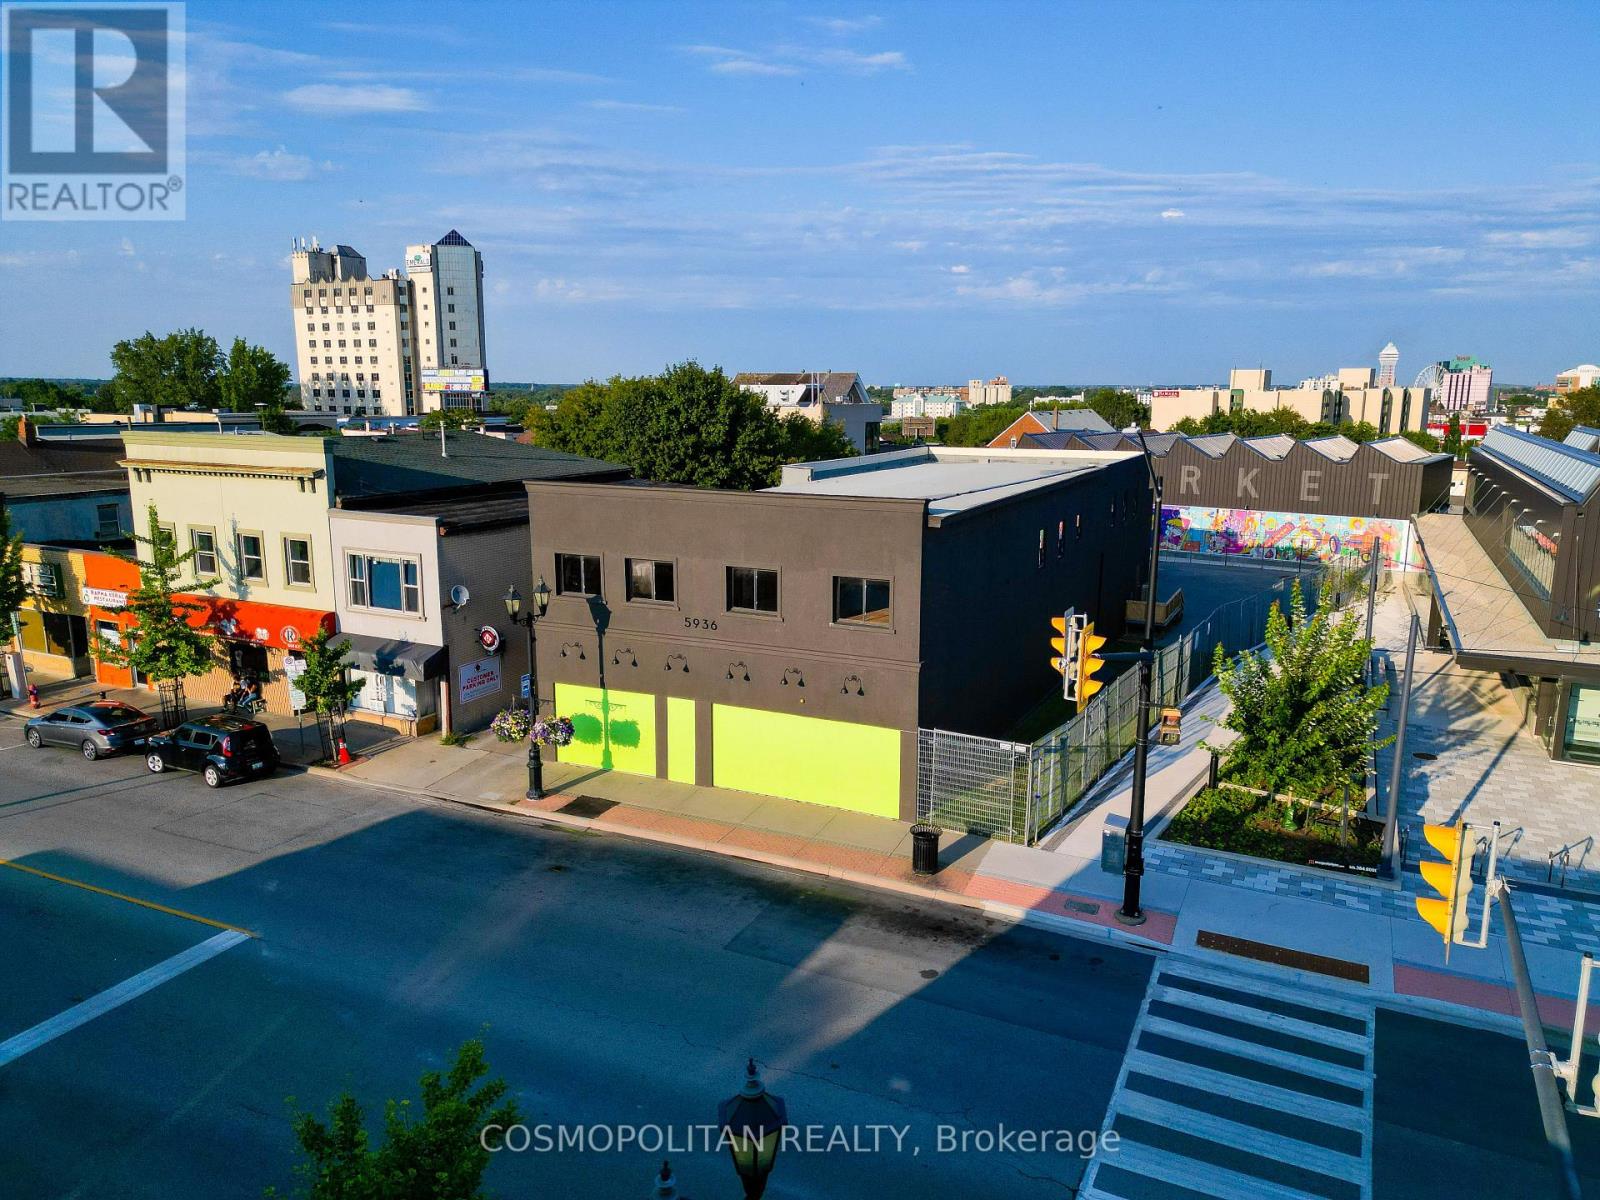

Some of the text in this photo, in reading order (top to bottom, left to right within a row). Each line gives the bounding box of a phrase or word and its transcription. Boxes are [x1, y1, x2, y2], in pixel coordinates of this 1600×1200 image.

[684, 616, 719, 632] 5936
[462, 679, 486, 692] PARKING
[486, 675, 498, 685] ONLY
[466, 671, 494, 684] CUSTOMER
